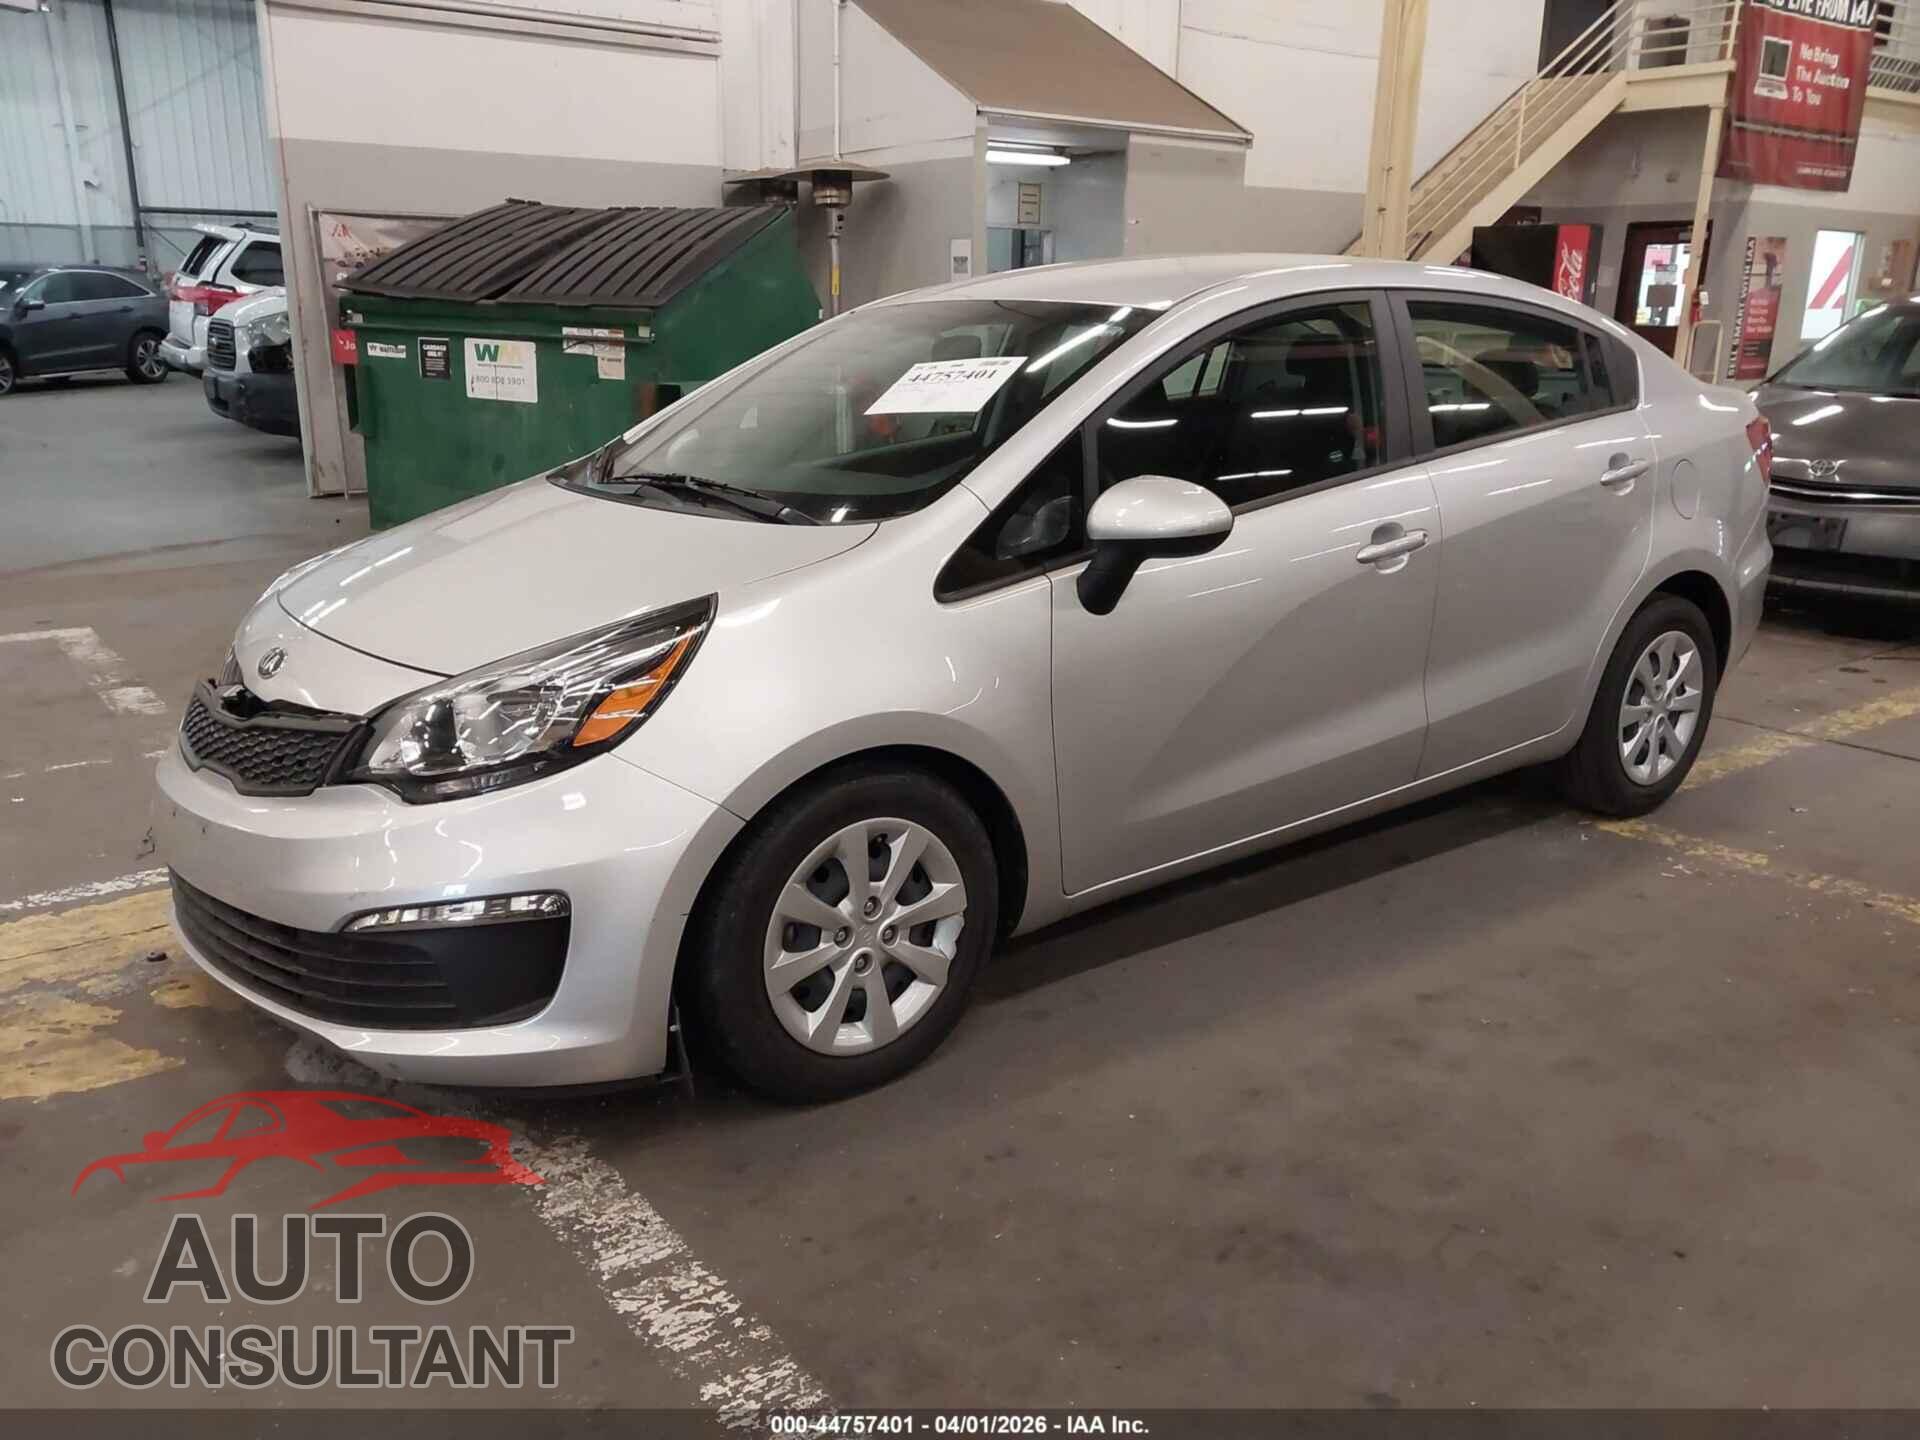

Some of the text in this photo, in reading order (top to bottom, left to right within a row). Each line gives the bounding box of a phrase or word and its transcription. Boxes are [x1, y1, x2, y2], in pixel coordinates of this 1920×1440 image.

[1813, 46, 1839, 69] Bring
[1796, 65, 1850, 89] The Auction
[1792, 86, 1822, 105] To You
[1733, 302, 1745, 344] SMART
[1741, 265, 1750, 298] WITH
